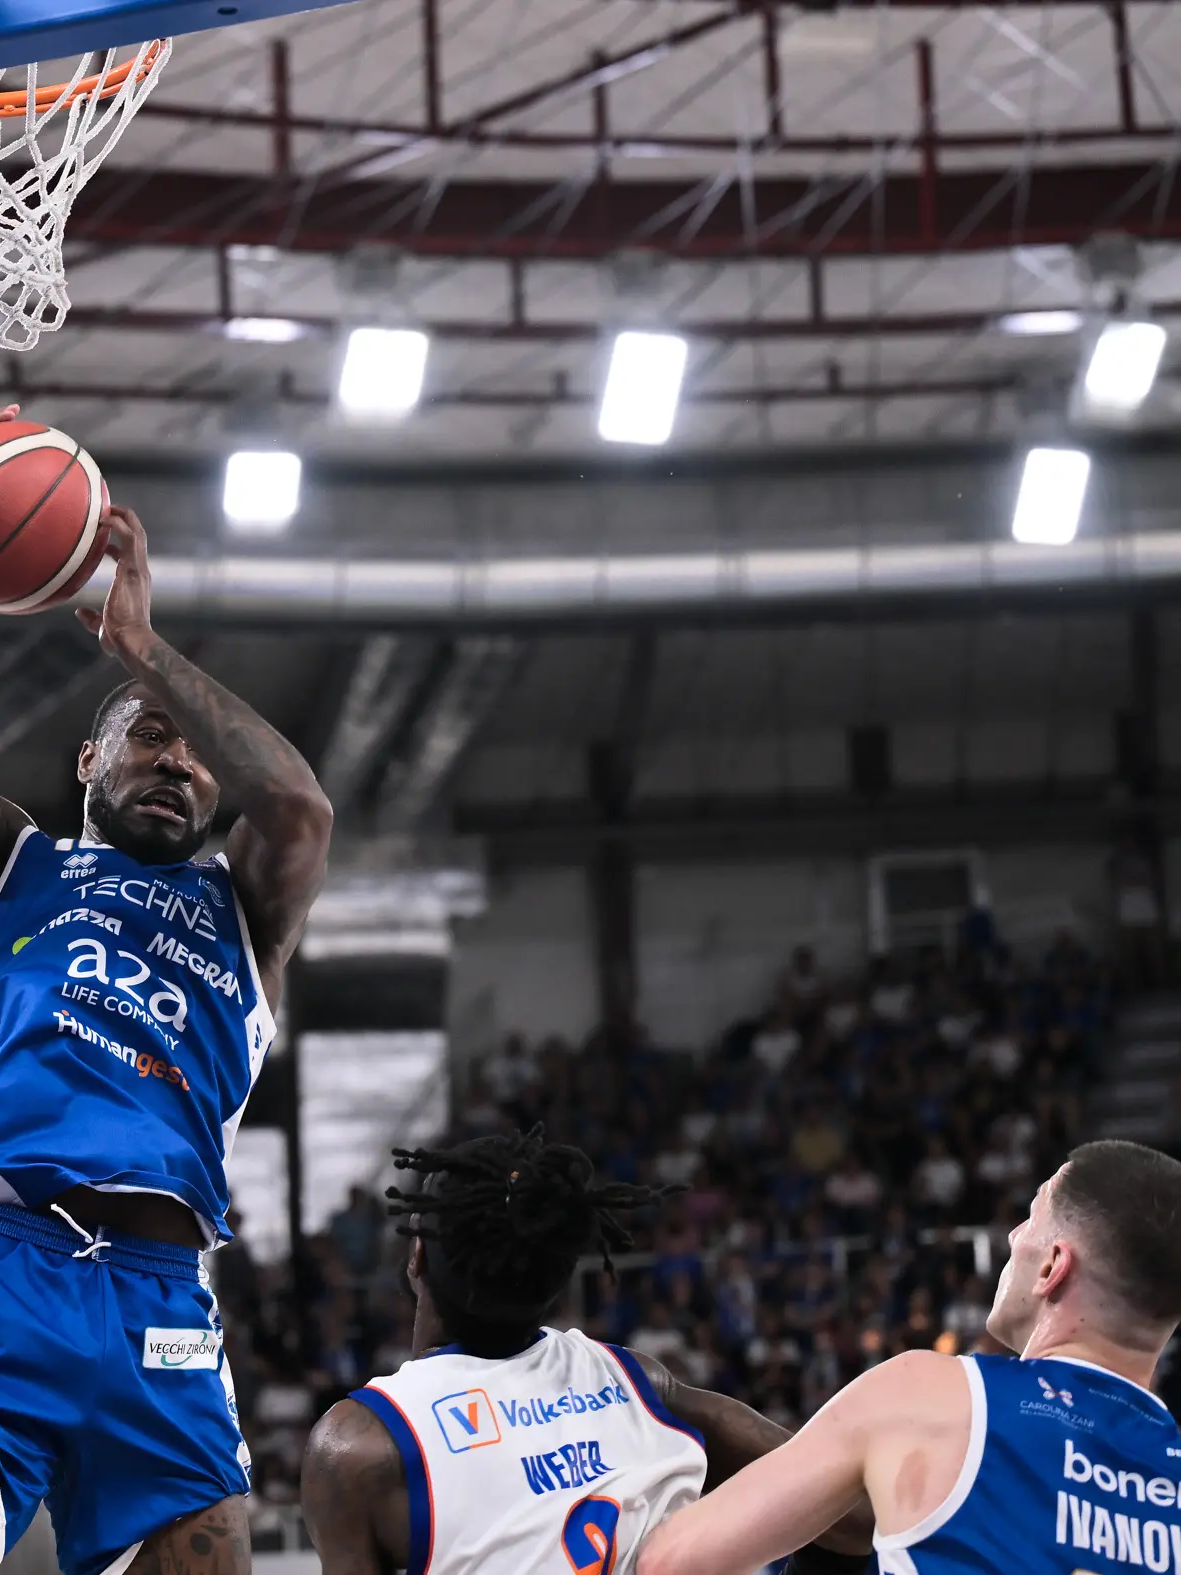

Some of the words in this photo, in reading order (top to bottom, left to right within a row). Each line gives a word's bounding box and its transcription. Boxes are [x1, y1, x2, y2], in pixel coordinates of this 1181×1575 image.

[60, 867, 97, 879] errea
[31, 908, 123, 936] azza
[72, 875, 217, 942] TECHNE
[61, 982, 100, 1006] LIFE
[67, 938, 186, 1033] a2a
[150, 1342, 185, 1355] VECCHI
[187, 1343, 216, 1355] ZIRONI
[498, 1377, 629, 1427] Volksbank
[520, 1440, 616, 1495] WEBER
